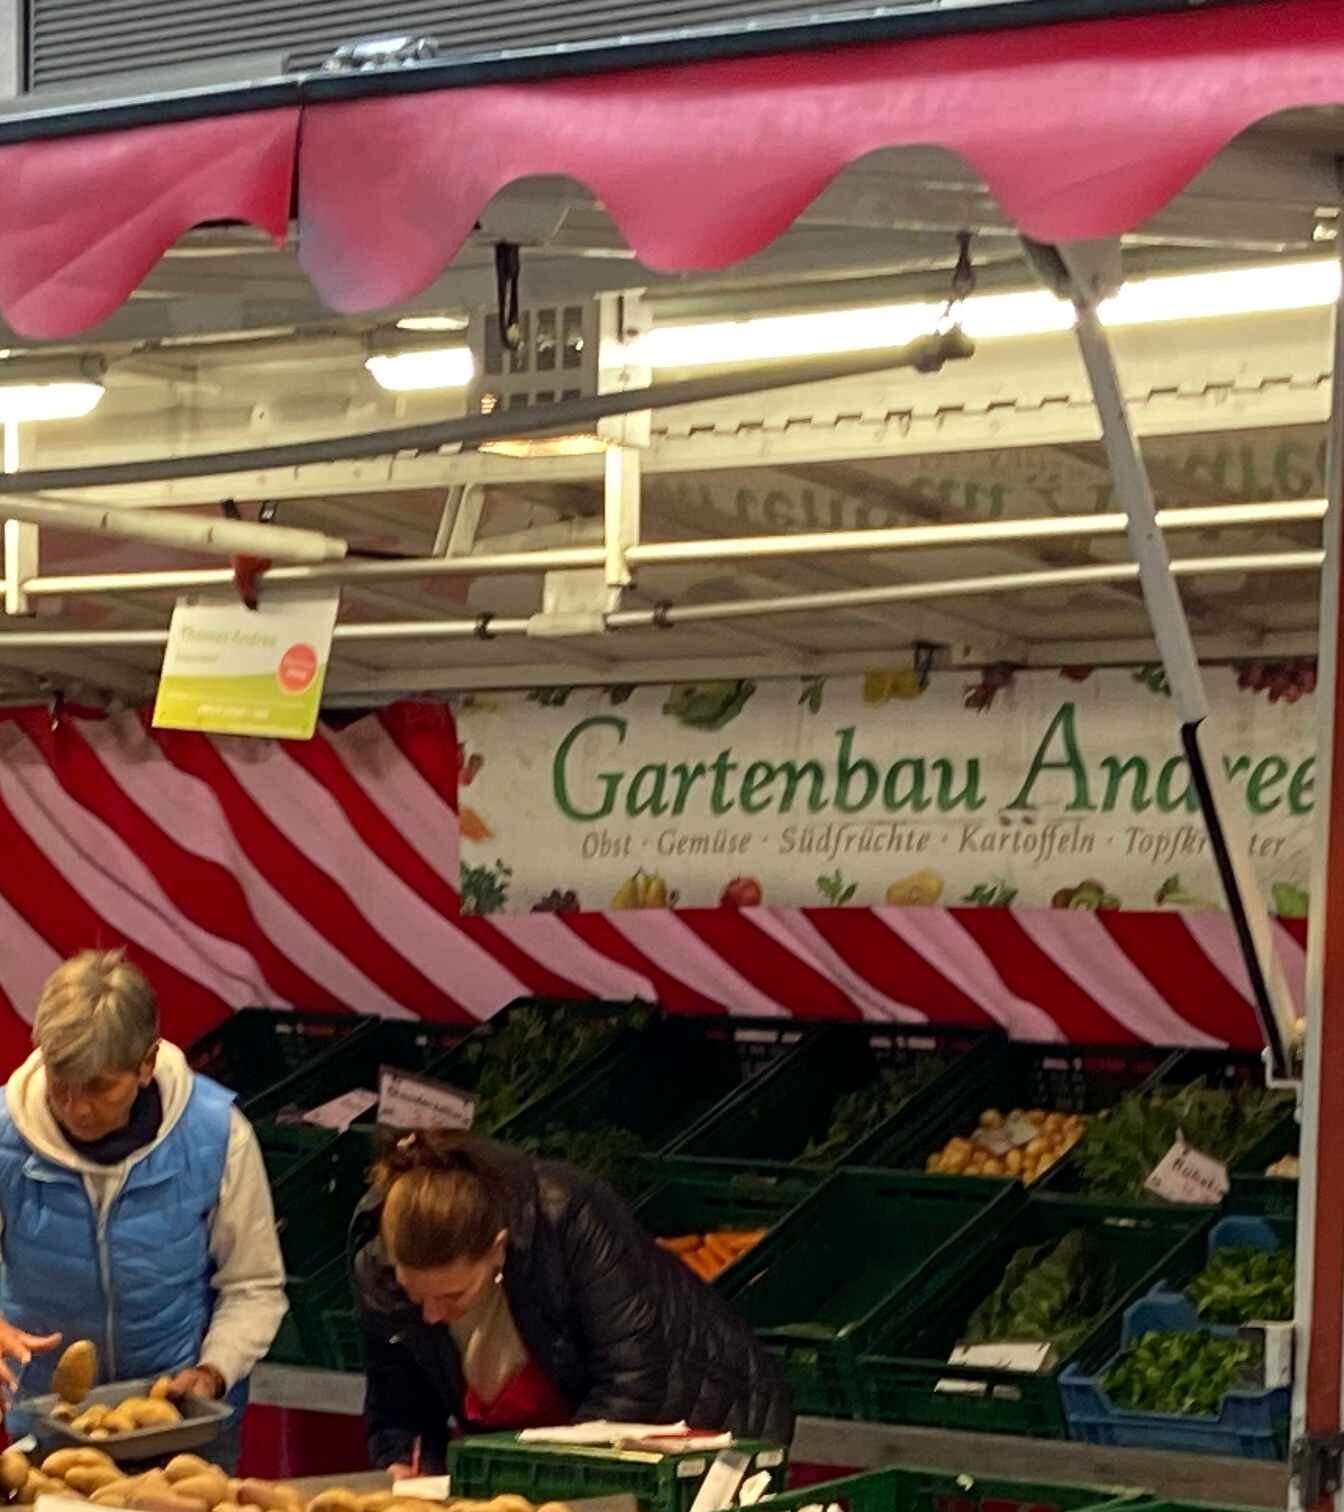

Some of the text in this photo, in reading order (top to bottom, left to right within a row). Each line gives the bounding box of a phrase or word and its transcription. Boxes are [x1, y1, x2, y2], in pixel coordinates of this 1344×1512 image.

[553, 714, 986, 822] Gartenbau
[581, 823, 1287, 863] Obst Gemüse Südfrüchte Kartoffeln Topfkrter
